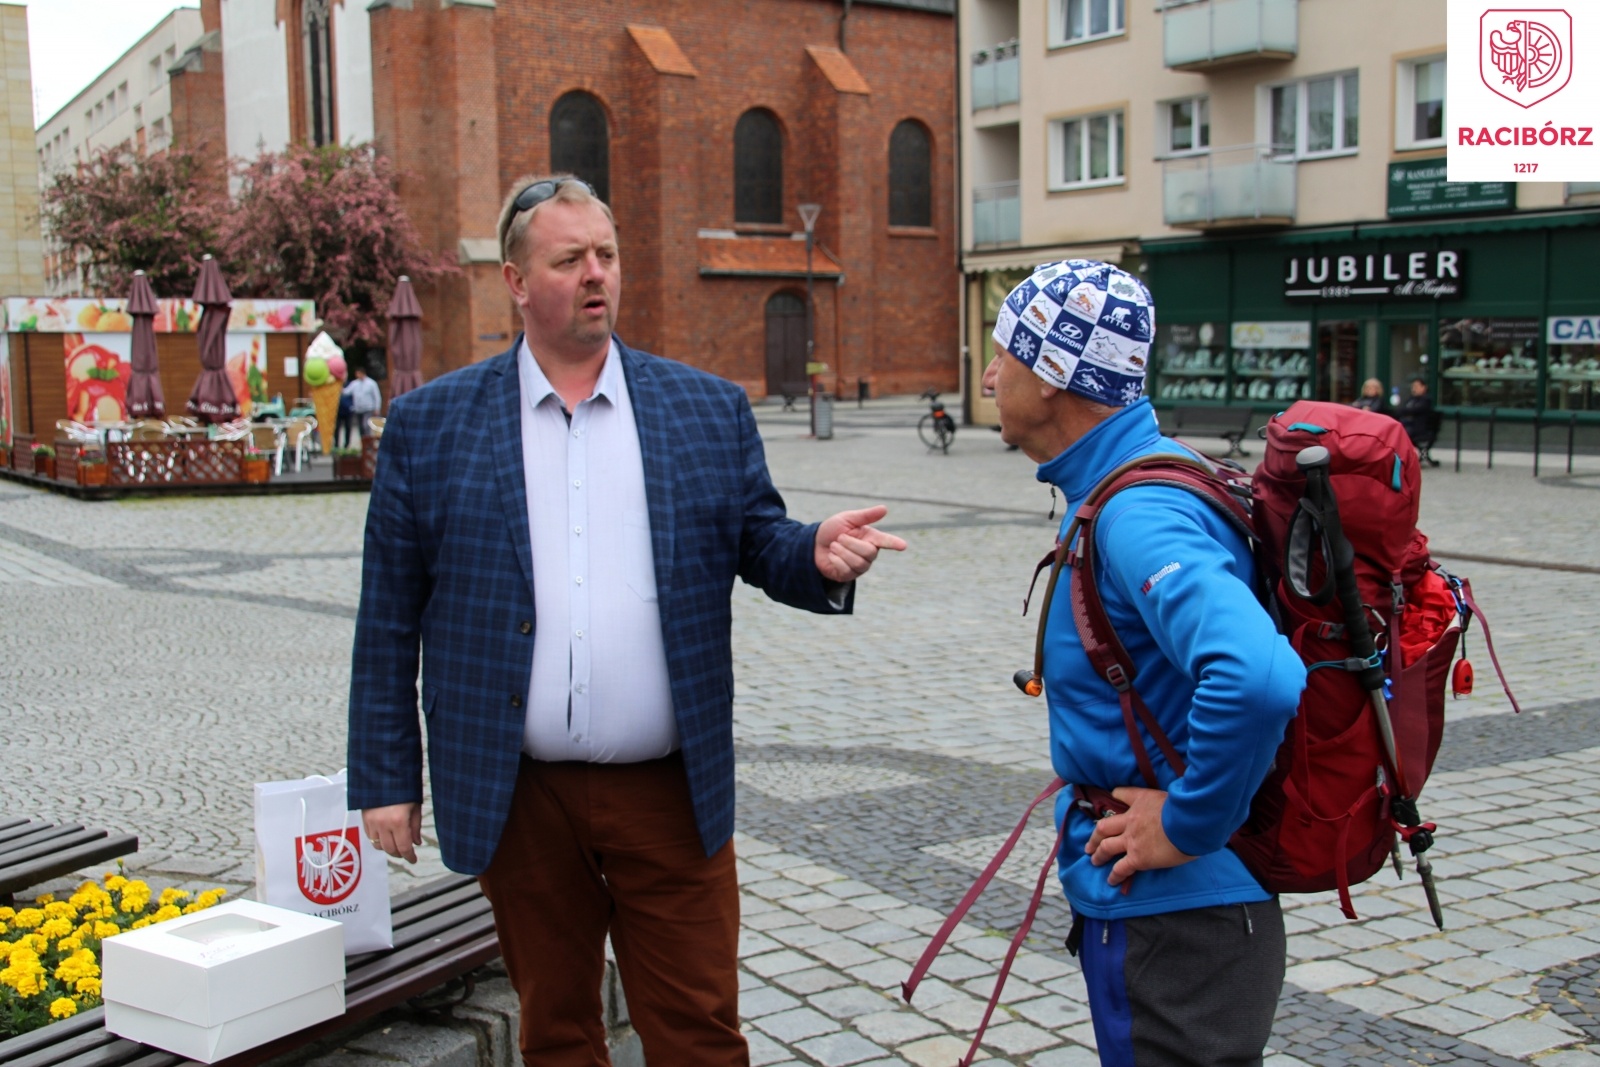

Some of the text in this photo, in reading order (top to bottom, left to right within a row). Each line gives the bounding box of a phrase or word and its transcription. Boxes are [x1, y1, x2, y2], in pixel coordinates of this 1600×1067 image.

[1284, 250, 1459, 284] JUBILER
[1049, 328, 1084, 351] HYUNDAI
[1553, 319, 1600, 340] CA
